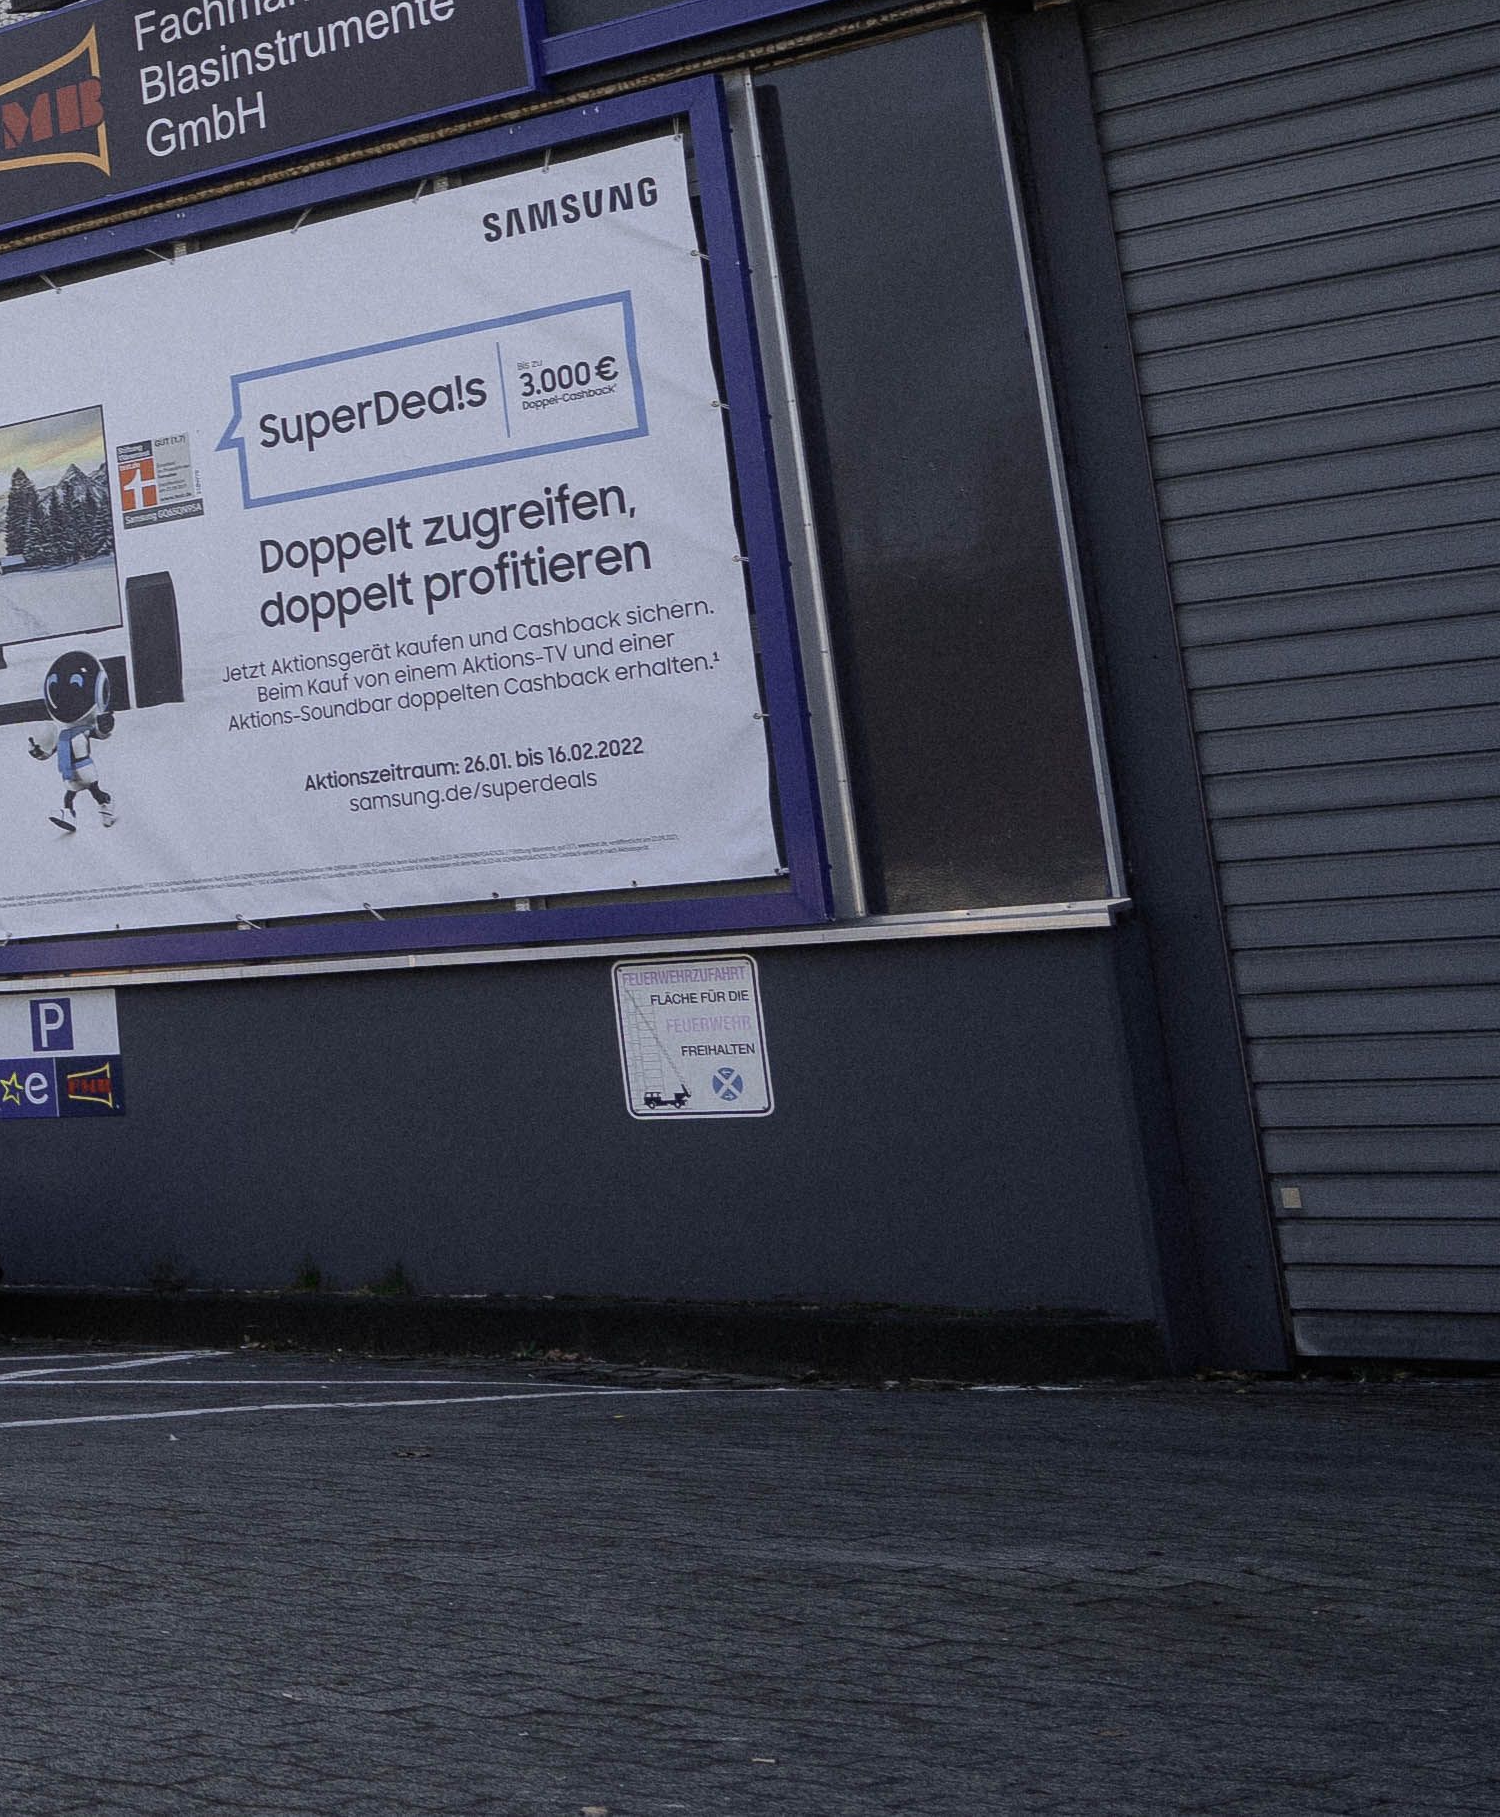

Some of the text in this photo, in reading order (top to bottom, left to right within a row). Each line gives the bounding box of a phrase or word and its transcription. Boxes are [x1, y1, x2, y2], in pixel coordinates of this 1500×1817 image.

[145, 92, 266, 157] GmbH
[483, 177, 658, 243] SAMSUNG
[260, 483, 636, 577] Doppelt zugreifen,
[260, 538, 652, 633] doppelt profitieren
[222, 600, 715, 682] Jetzt Aktionsgerät kaufen und Cashback sichern.
[257, 632, 675, 702] Beim Kauf von einem Aktions-TV und einer
[228, 696, 392, 732] Aktions-Soundbar
[397, 681, 500, 712] doppelten
[504, 666, 610, 695] Cashback
[305, 736, 644, 792] Aktionszeitraum: 26.01. bis 16.02.2022
[349, 769, 598, 812] samsung.de/superdeals
[622, 966, 746, 987] FEUERWEHRZUFAHRT
[650, 989, 749, 1005] FLÄCHE FÜR DIE
[39, 1003, 65, 1048] P
[666, 1015, 751, 1033] FEUERWEHR
[681, 1043, 756, 1057] FREIHALTEN
[25, 1072, 49, 1105] e
